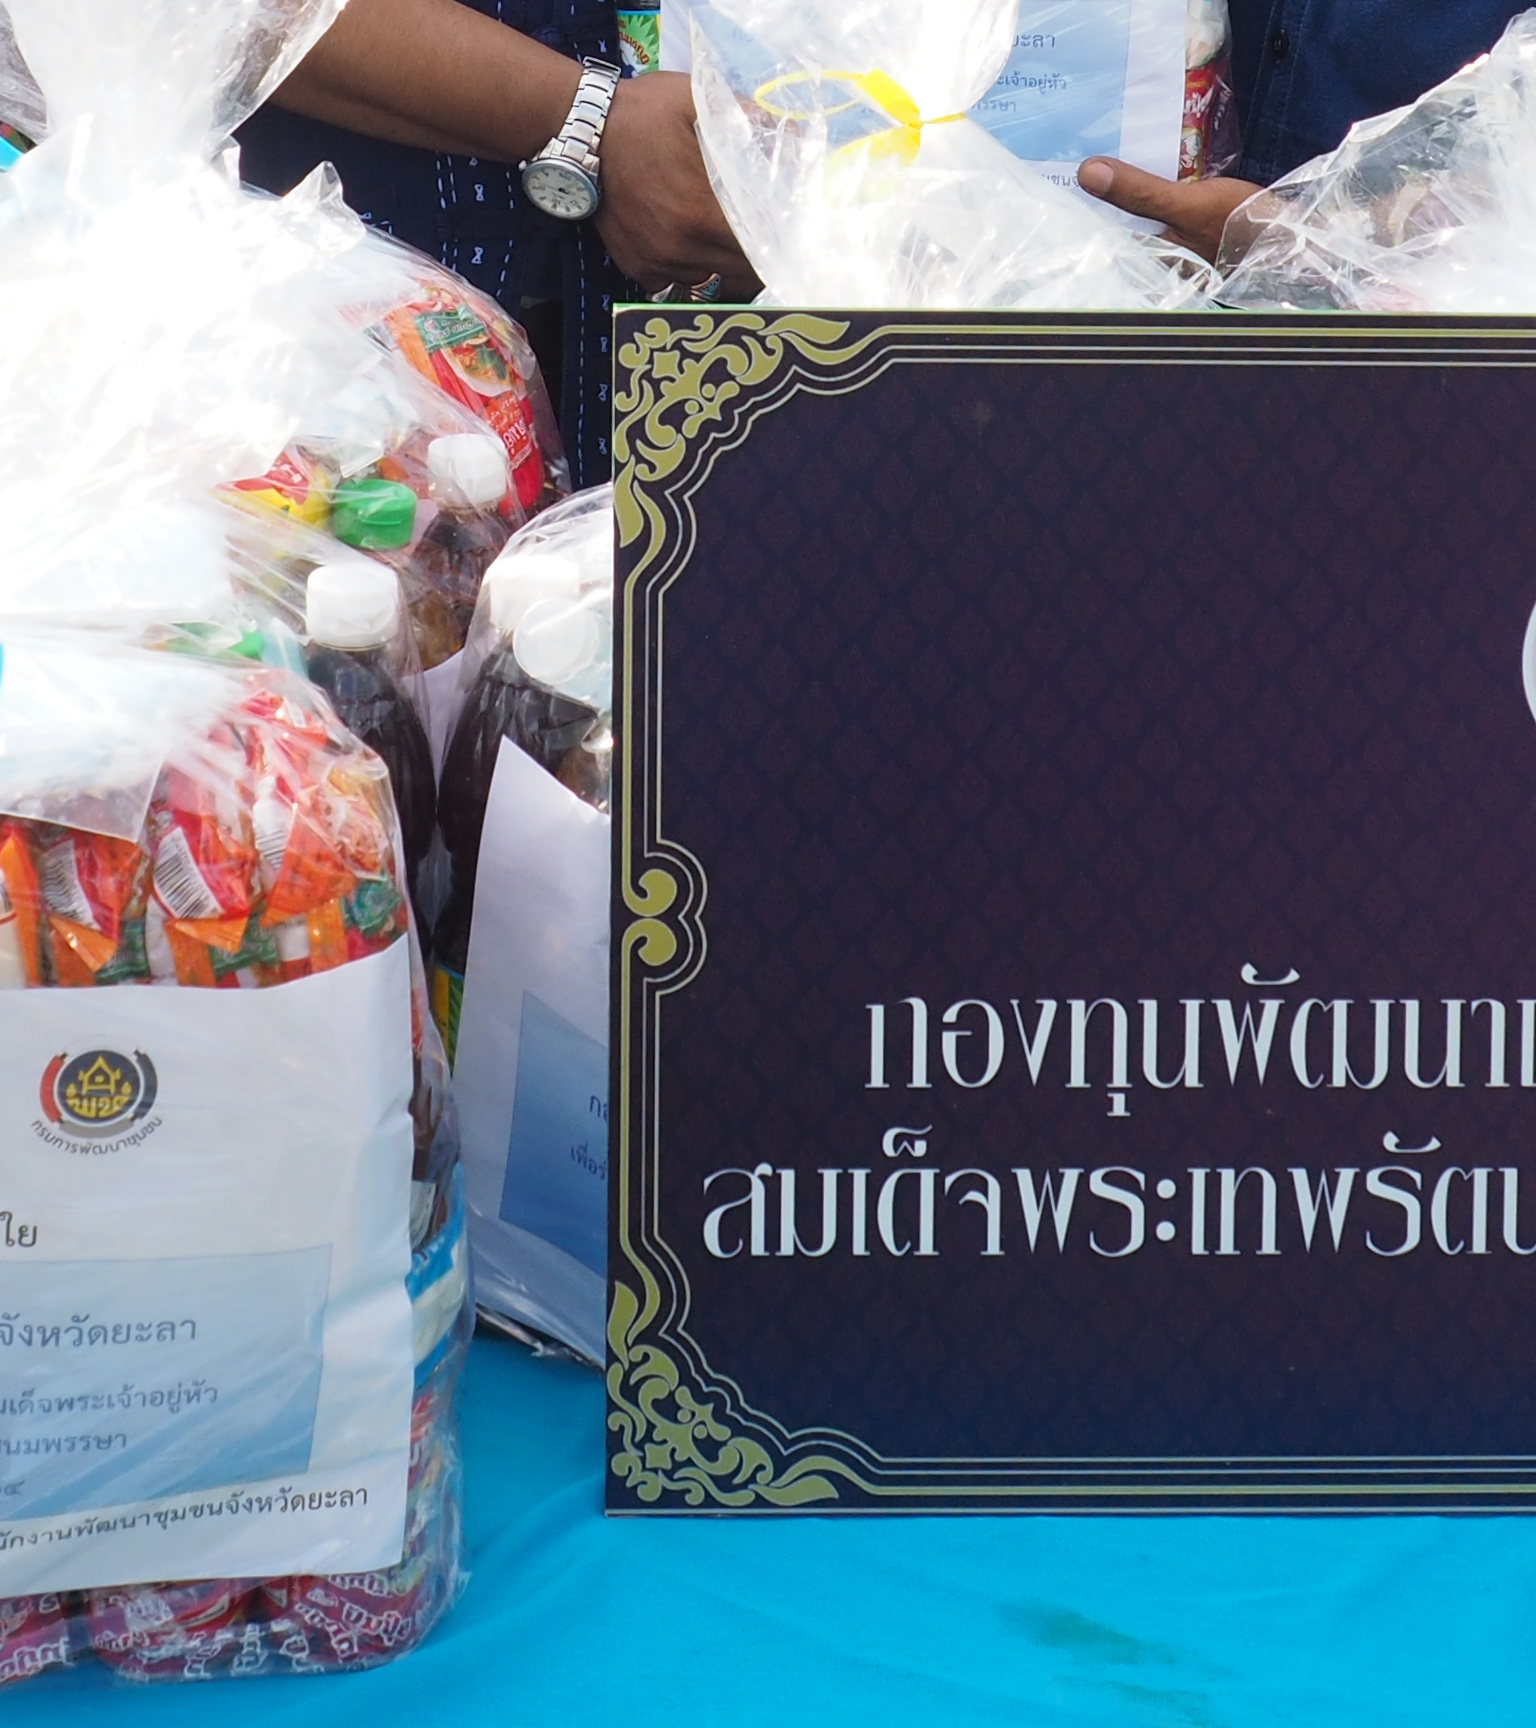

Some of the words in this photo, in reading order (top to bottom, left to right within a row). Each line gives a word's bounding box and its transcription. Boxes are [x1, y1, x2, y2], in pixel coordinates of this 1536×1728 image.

[29, 1115, 164, 1156] กรมการพัฒนาชุมชน
